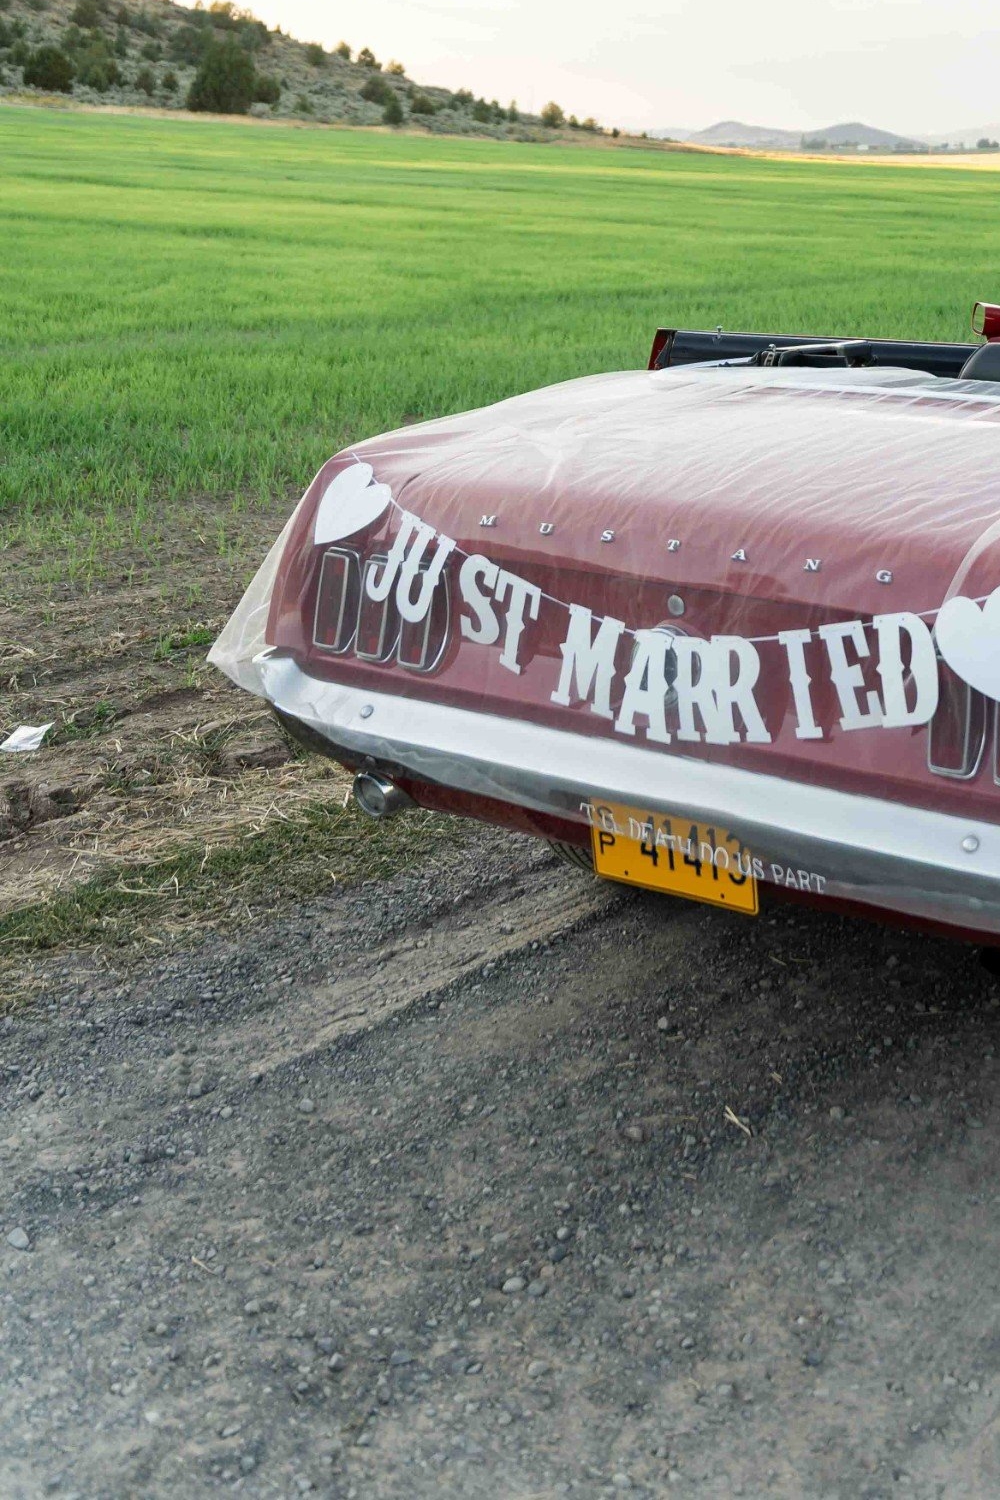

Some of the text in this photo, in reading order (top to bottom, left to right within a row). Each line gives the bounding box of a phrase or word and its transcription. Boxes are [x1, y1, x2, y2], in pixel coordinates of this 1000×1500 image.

[478, 514, 893, 584] MUSTANG
[366, 509, 940, 745] JUST MARRIED
[628, 815, 692, 857] DEATH
[700, 841, 729, 870] DO
[736, 851, 766, 880] US
[770, 863, 827, 895] PART
